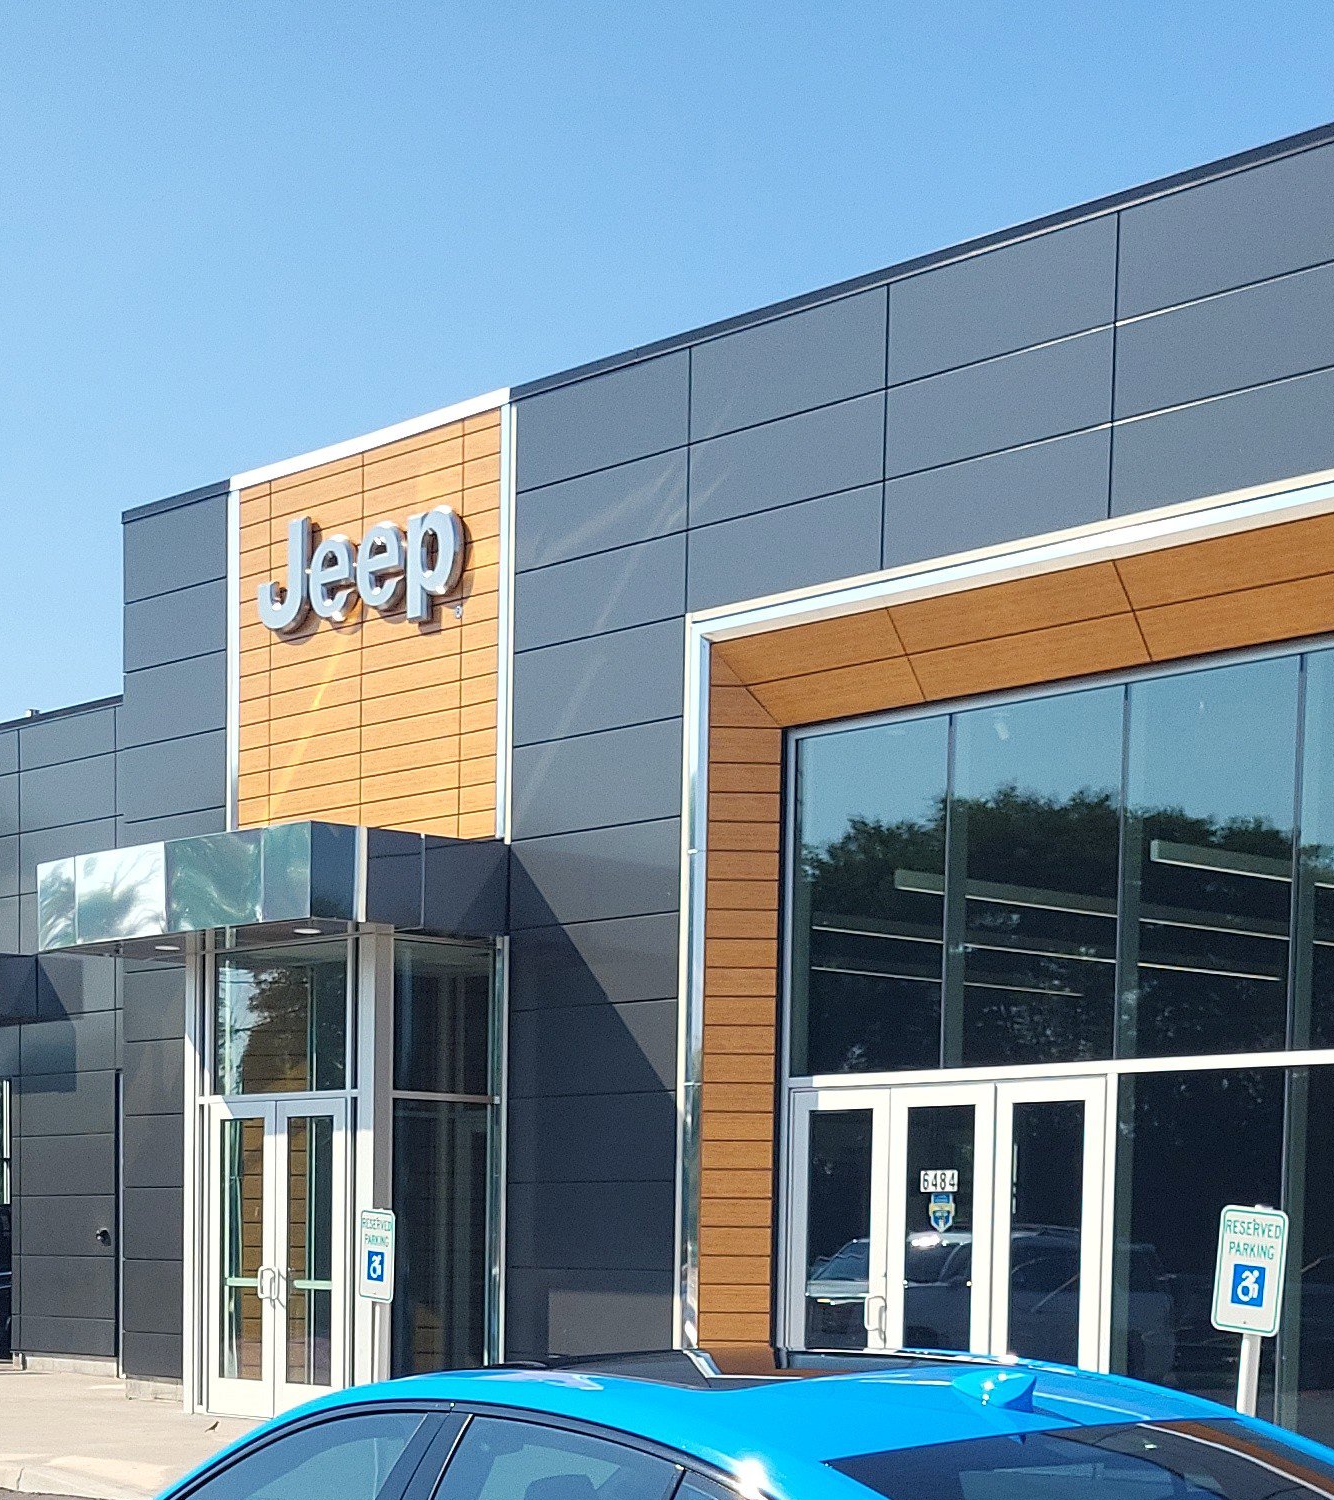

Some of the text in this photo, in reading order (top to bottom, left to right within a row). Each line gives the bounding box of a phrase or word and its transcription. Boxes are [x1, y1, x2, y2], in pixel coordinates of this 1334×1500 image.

[257, 504, 465, 631] Jeep
[922, 1172, 956, 1190] 6484
[1225, 1219, 1282, 1240] RESERVED
[1229, 1241, 1275, 1260] PARKING
